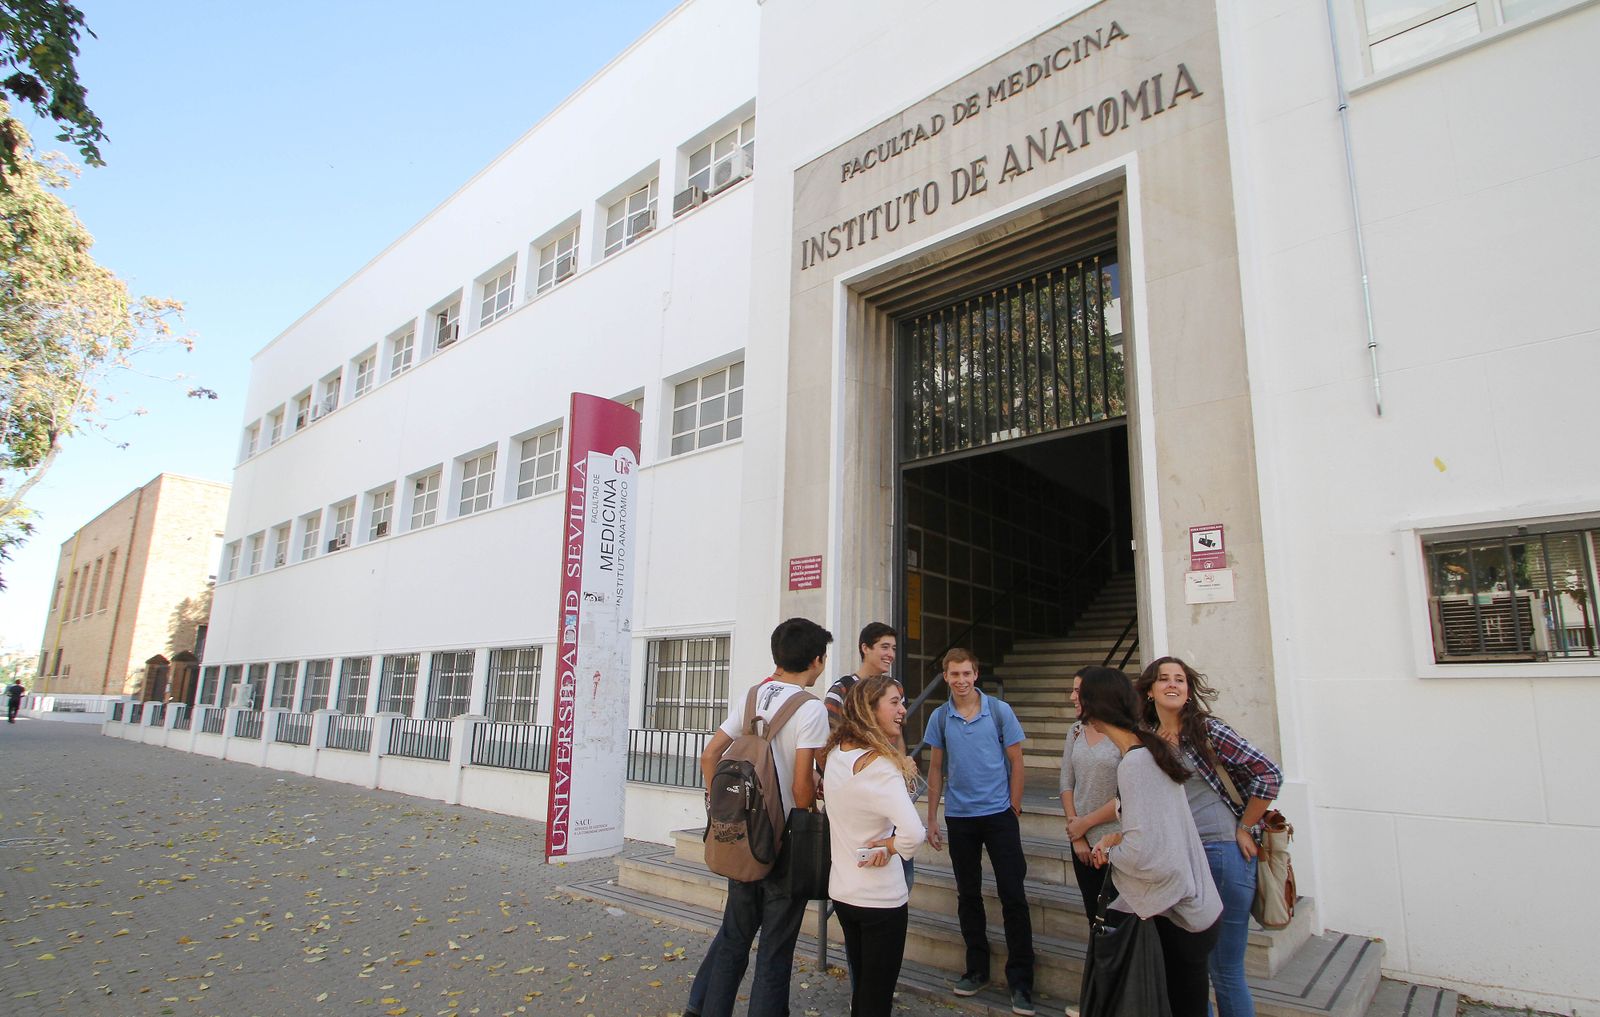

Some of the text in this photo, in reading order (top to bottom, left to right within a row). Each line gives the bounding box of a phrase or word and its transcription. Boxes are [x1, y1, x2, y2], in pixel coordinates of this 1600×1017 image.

[840, 20, 1130, 183] FACULTAD DE MEDICINA
[800, 62, 1204, 271] INSTITUTO DE ANATOMIA
[567, 457, 587, 578] SEVILLA
[591, 473, 601, 523] FACULTAD DE
[600, 478, 617, 571] MEDICINA
[617, 481, 628, 546] ANATÓMICO
